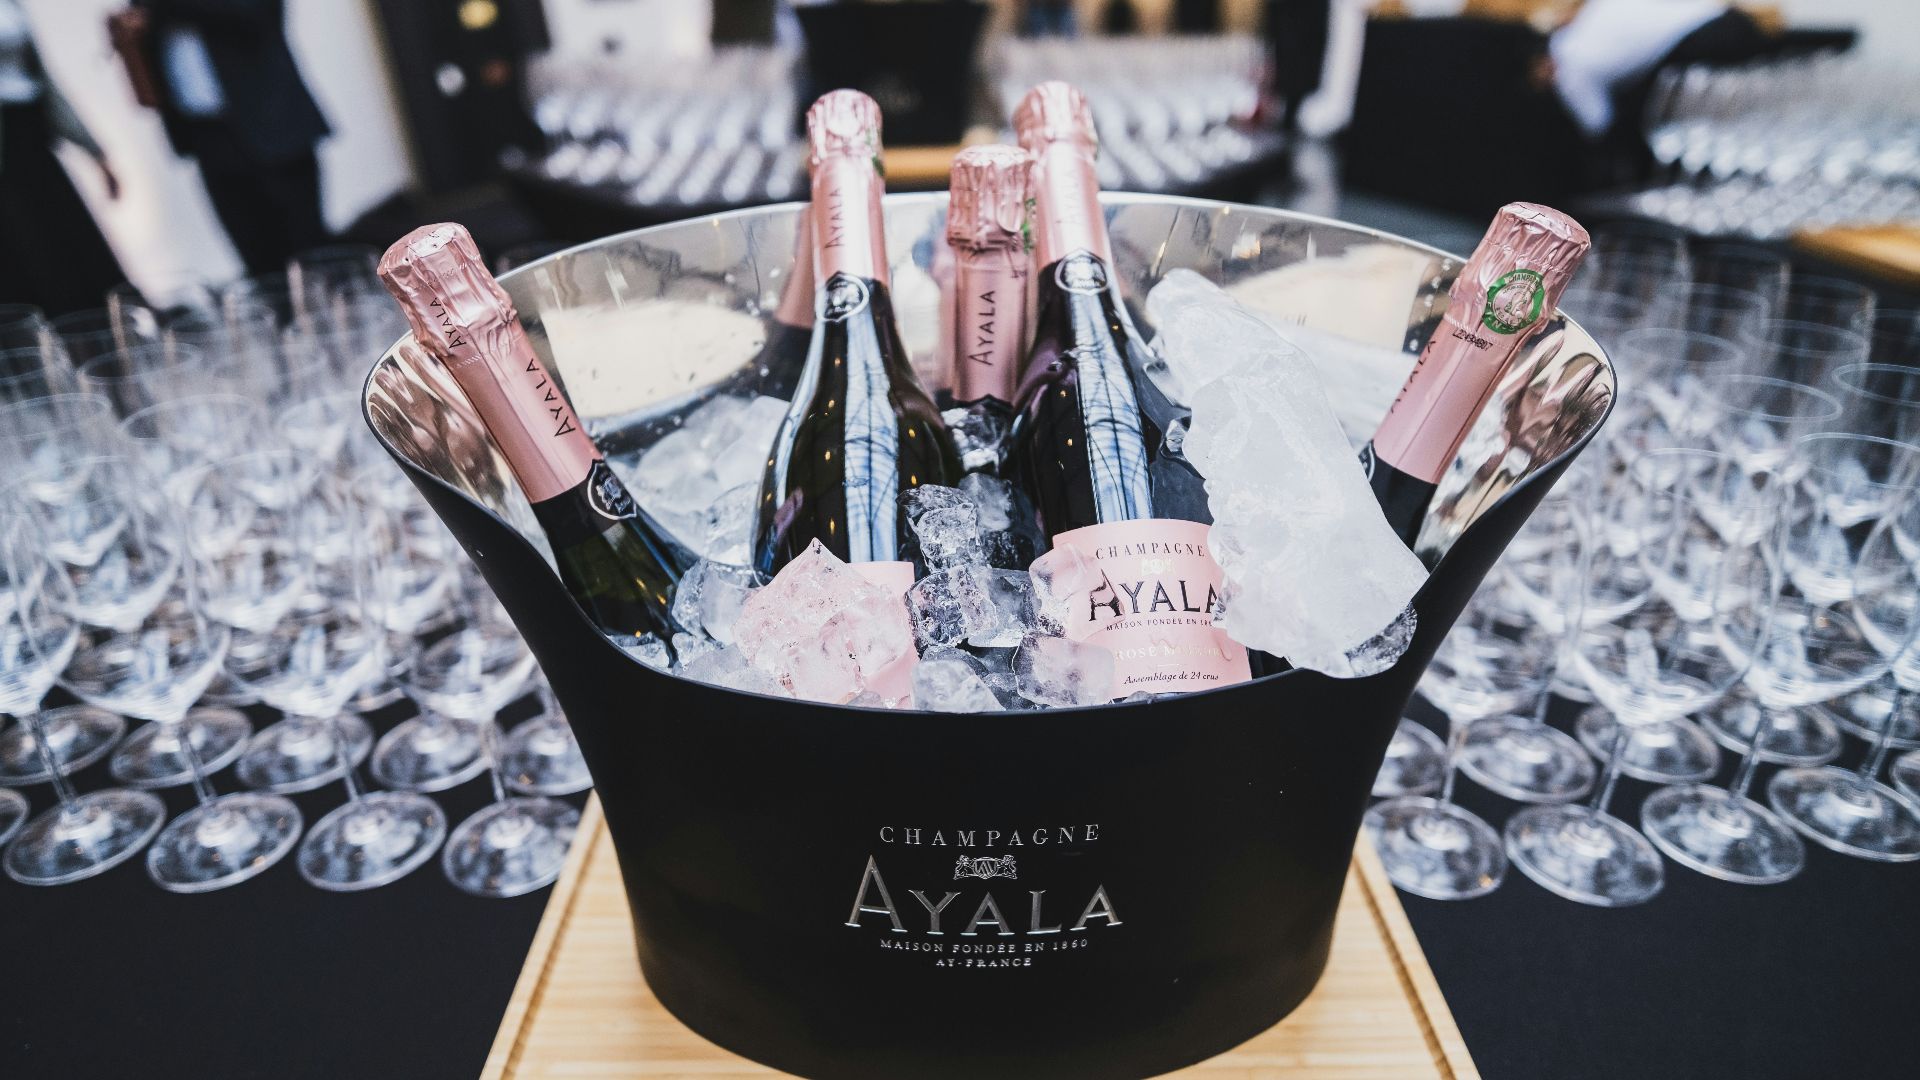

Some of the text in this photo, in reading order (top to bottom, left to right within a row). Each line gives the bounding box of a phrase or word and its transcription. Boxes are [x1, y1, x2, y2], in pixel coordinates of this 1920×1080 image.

[824, 186, 845, 249] AYALA
[429, 297, 467, 349] AYALA
[969, 289, 996, 367] AYALA
[525, 358, 576, 438] AYALA
[1095, 541, 1206, 560] CHAMPAGNE
[1105, 619, 1142, 632] MAISON
[1186, 617, 1197, 625] EN
[1123, 670, 1219, 685] Assemblage de 24 crus
[879, 823, 1100, 847] CHAMPAGNE
[845, 854, 1123, 936] AYALA
[880, 939, 943, 952] MAISON
[1024, 942, 1044, 952] EN
[1053, 938, 1088, 951] 1860
[936, 958, 1032, 968] AY-FRANCE
